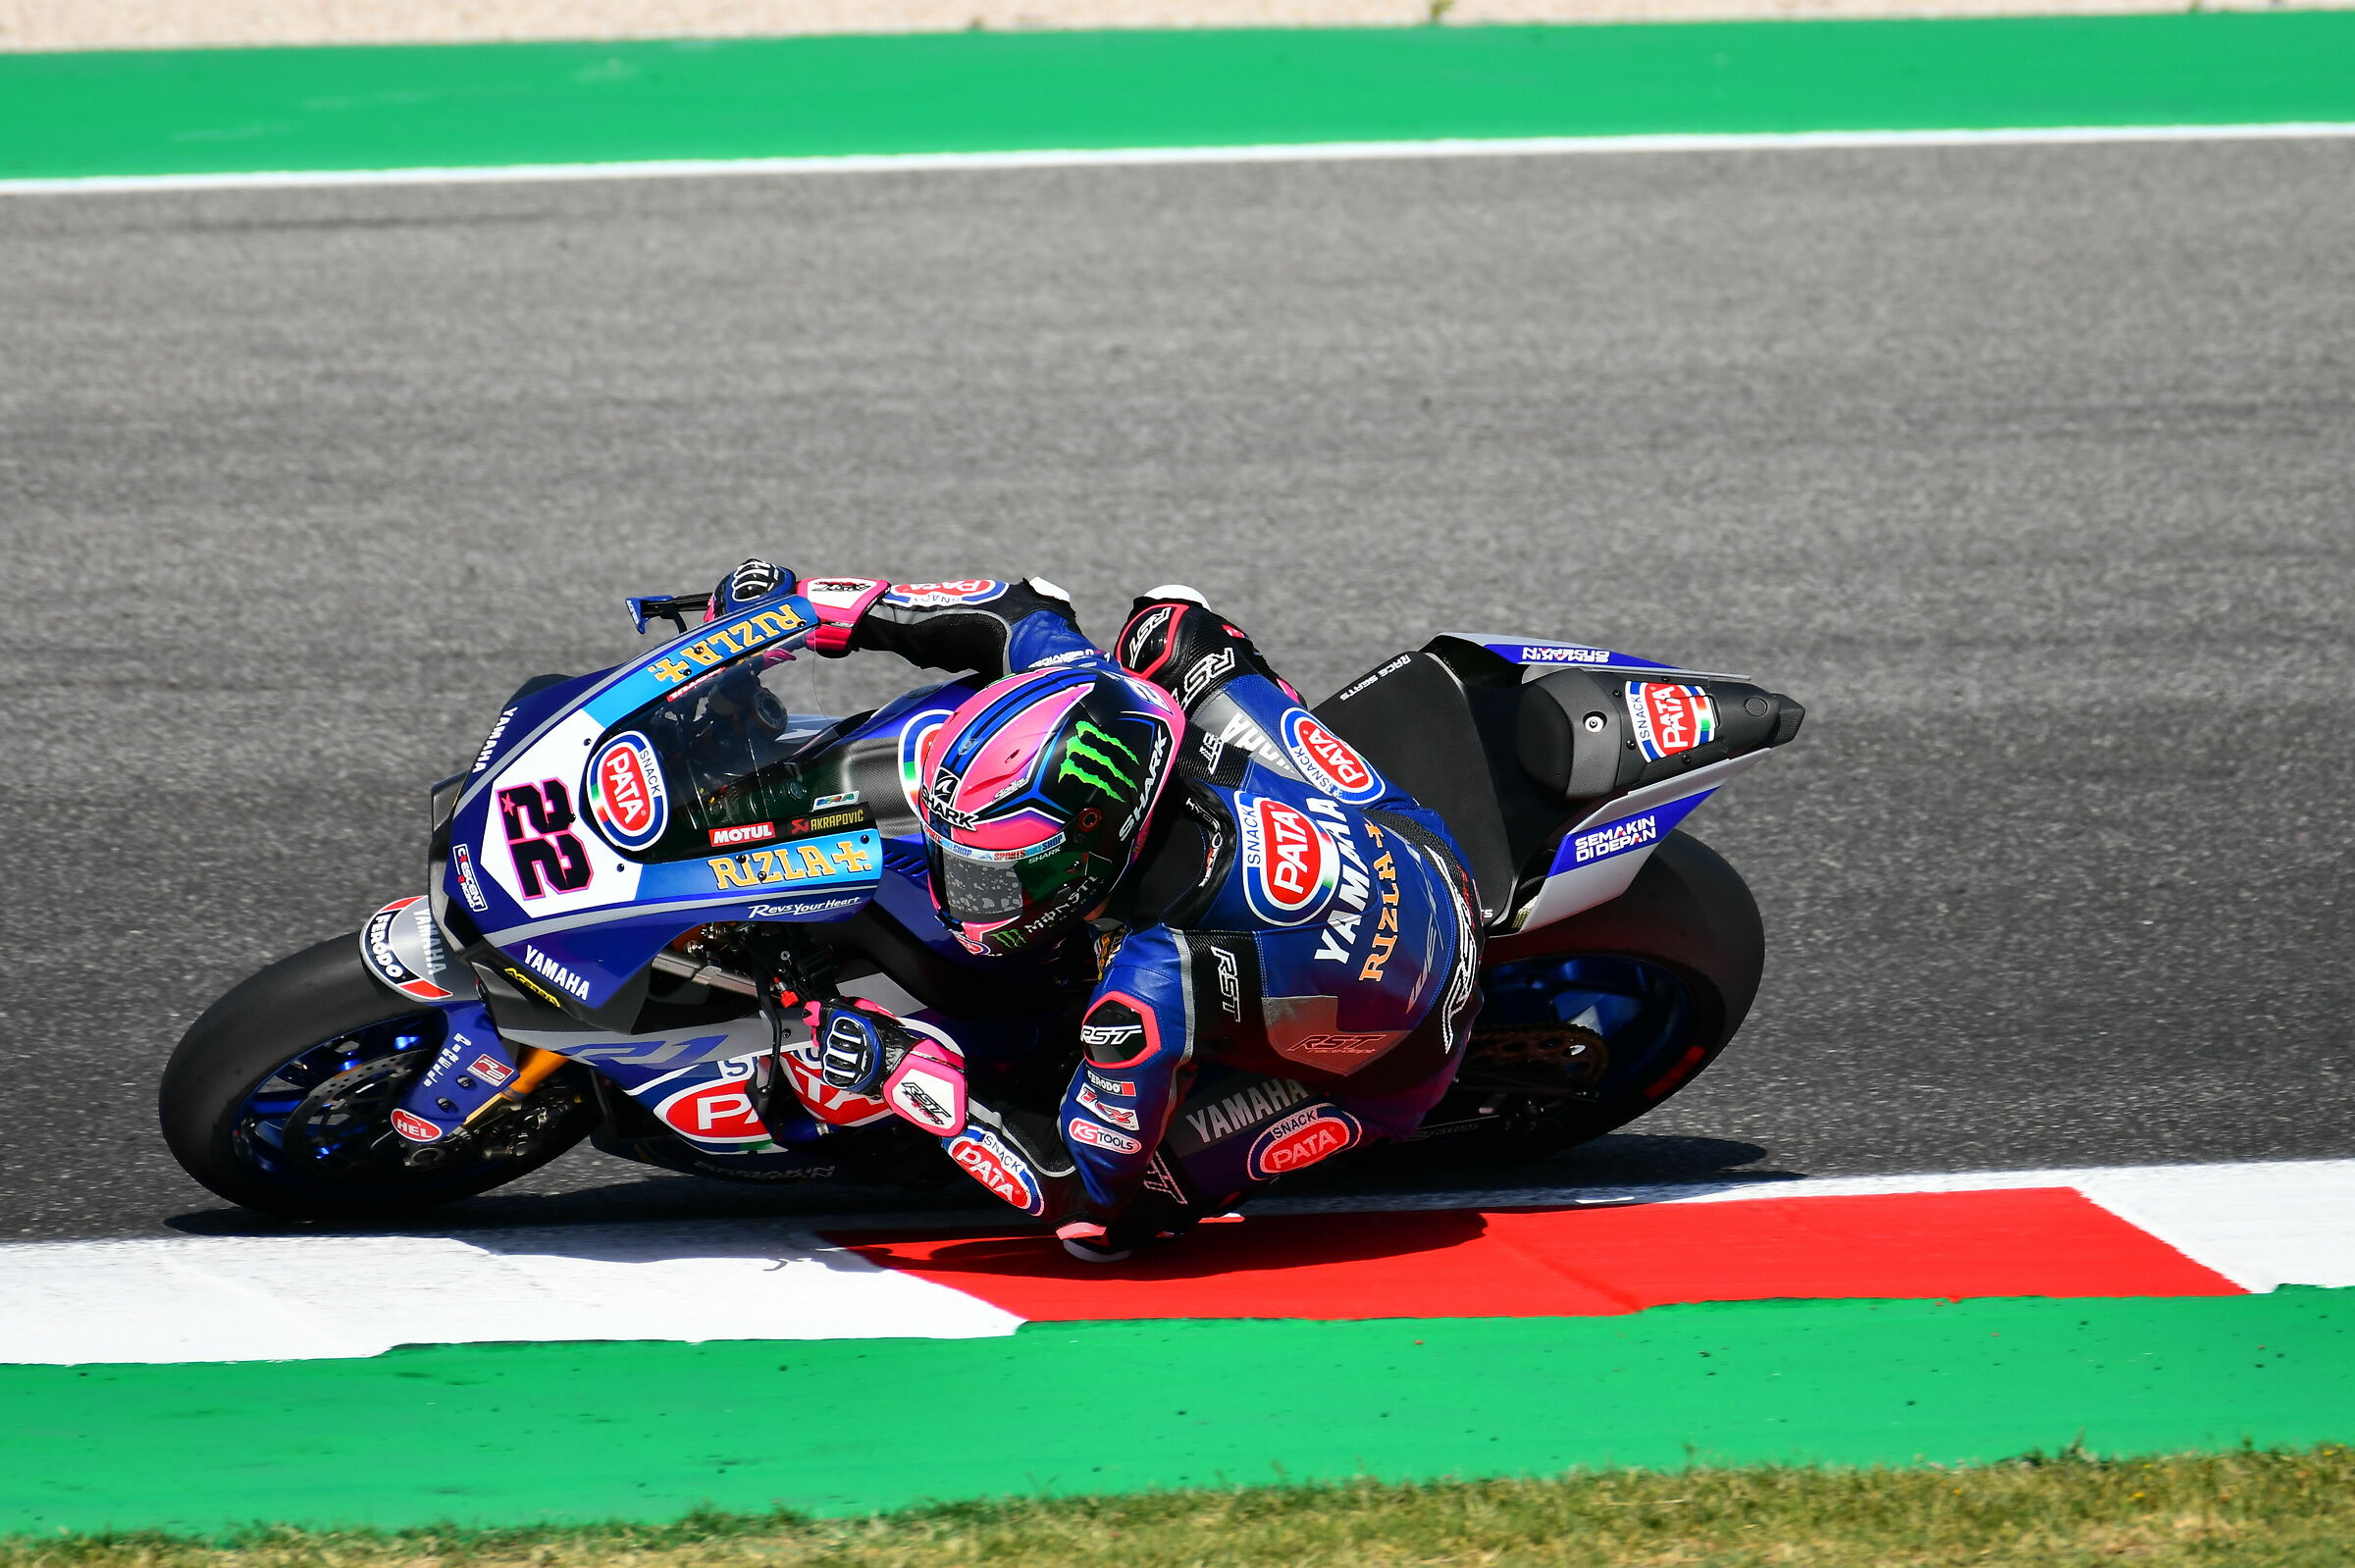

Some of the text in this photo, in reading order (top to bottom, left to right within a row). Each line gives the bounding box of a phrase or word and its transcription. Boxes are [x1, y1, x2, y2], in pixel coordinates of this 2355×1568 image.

[1129, 607, 1172, 668] RST
[1340, 654, 1411, 701] RACE SEATS
[472, 706, 518, 773] YAMAHA
[1632, 696, 1650, 739] SNACK
[1651, 686, 1689, 748] PATA
[640, 750, 661, 794] SNACK
[1120, 724, 1167, 841] SHARK
[1294, 747, 1332, 789] SNACK
[1307, 727, 1365, 784] PATA
[605, 752, 641, 824] PATA
[921, 785, 979, 832] SHARK
[495, 776, 595, 901] 22
[713, 824, 773, 844] MOTUL
[1028, 846, 1062, 864] SHARK
[1242, 807, 1261, 864] SNACK
[1270, 811, 1309, 894] PATA
[1575, 815, 1656, 851] SEMAKIN
[1575, 827, 1657, 862] DI DEPAN
[457, 848, 485, 908] CRESCENT
[1305, 798, 1370, 965] YAMAHA
[369, 913, 405, 978] FERODO
[413, 909, 447, 976] YAMAHA
[523, 944, 591, 1001] YAMAHA
[1211, 946, 1241, 1022] RST
[424, 1033, 471, 1087] PIRELLI
[1079, 1024, 1143, 1045] RST
[1287, 1034, 1387, 1052] RST
[901, 1082, 952, 1118] RST
[1185, 1079, 1310, 1143] YAMAHA
[1273, 1112, 1318, 1139] SNACK
[396, 1120, 433, 1138] HEL
[984, 1136, 1021, 1174] SNACK
[1073, 1124, 1134, 1150] KS TOOLS
[1272, 1130, 1338, 1169] PATA
[956, 1147, 1015, 1203] PATA
